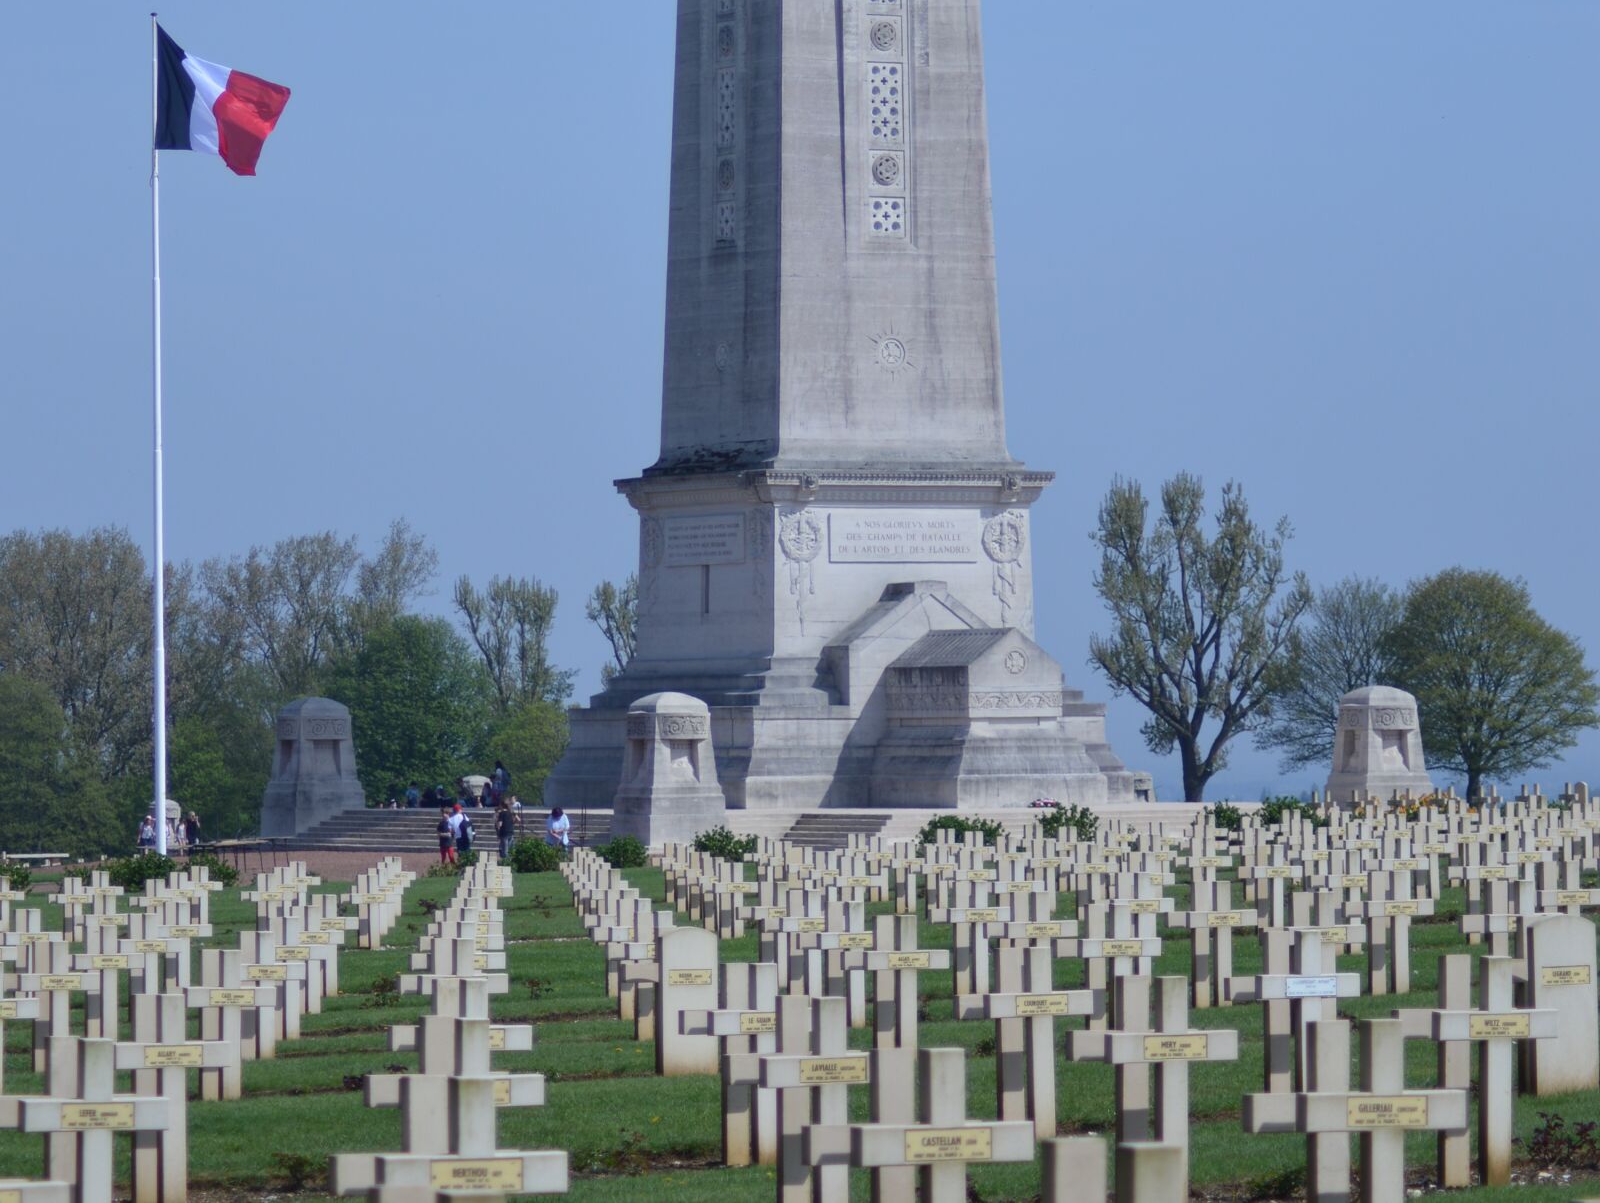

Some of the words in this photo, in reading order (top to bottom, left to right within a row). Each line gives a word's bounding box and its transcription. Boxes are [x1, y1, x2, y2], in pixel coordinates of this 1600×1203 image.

[864, 521, 881, 529] NOS
[927, 521, 956, 529] MORTS
[846, 533, 862, 541] DES
[868, 533, 903, 542] CHAMPS
[906, 533, 916, 542] DE
[922, 533, 962, 542] BATAILLE
[838, 545, 848, 554] DE
[895, 545, 904, 553] ET
[909, 545, 925, 554] DES
[929, 545, 971, 554] FLANDRES
[811, 1063, 838, 1072] LAVIALLE
[921, 1136, 962, 1147] CASTELLAN
[452, 1168, 488, 1178] BERTHOU
